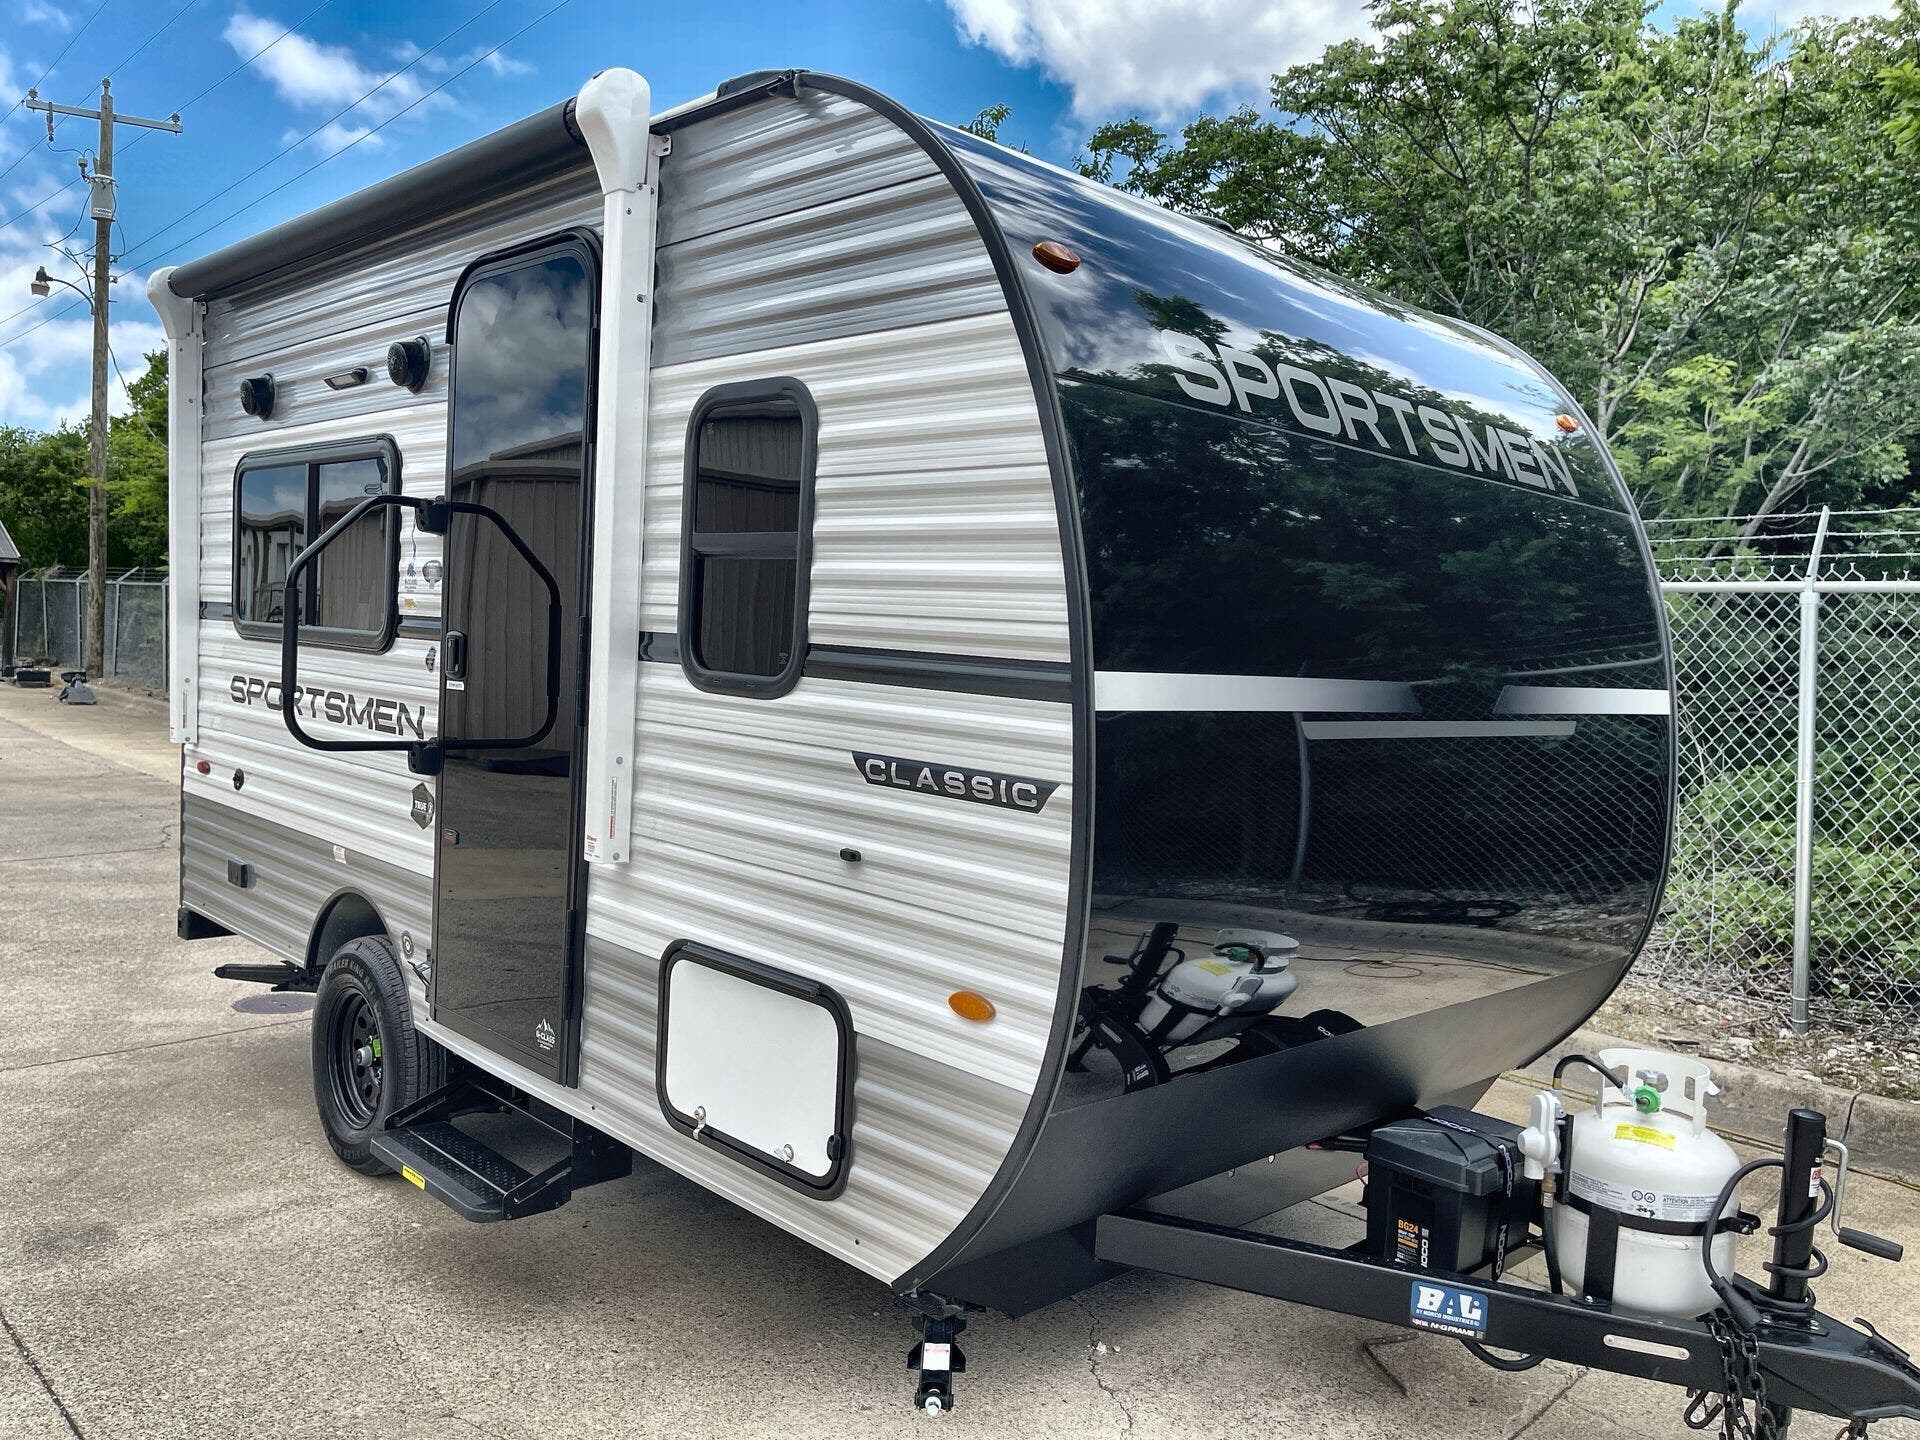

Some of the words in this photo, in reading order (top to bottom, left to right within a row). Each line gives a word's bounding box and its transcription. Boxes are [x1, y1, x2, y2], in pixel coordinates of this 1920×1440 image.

[1160, 328, 1581, 498] SPORTSMEN
[865, 758, 1038, 808] CLASSIC
[349, 959, 365, 978] KING
[1397, 1219, 1420, 1235] BG24
[1417, 1285, 1482, 1321] BAL
[1447, 1325, 1476, 1338] FRAME
